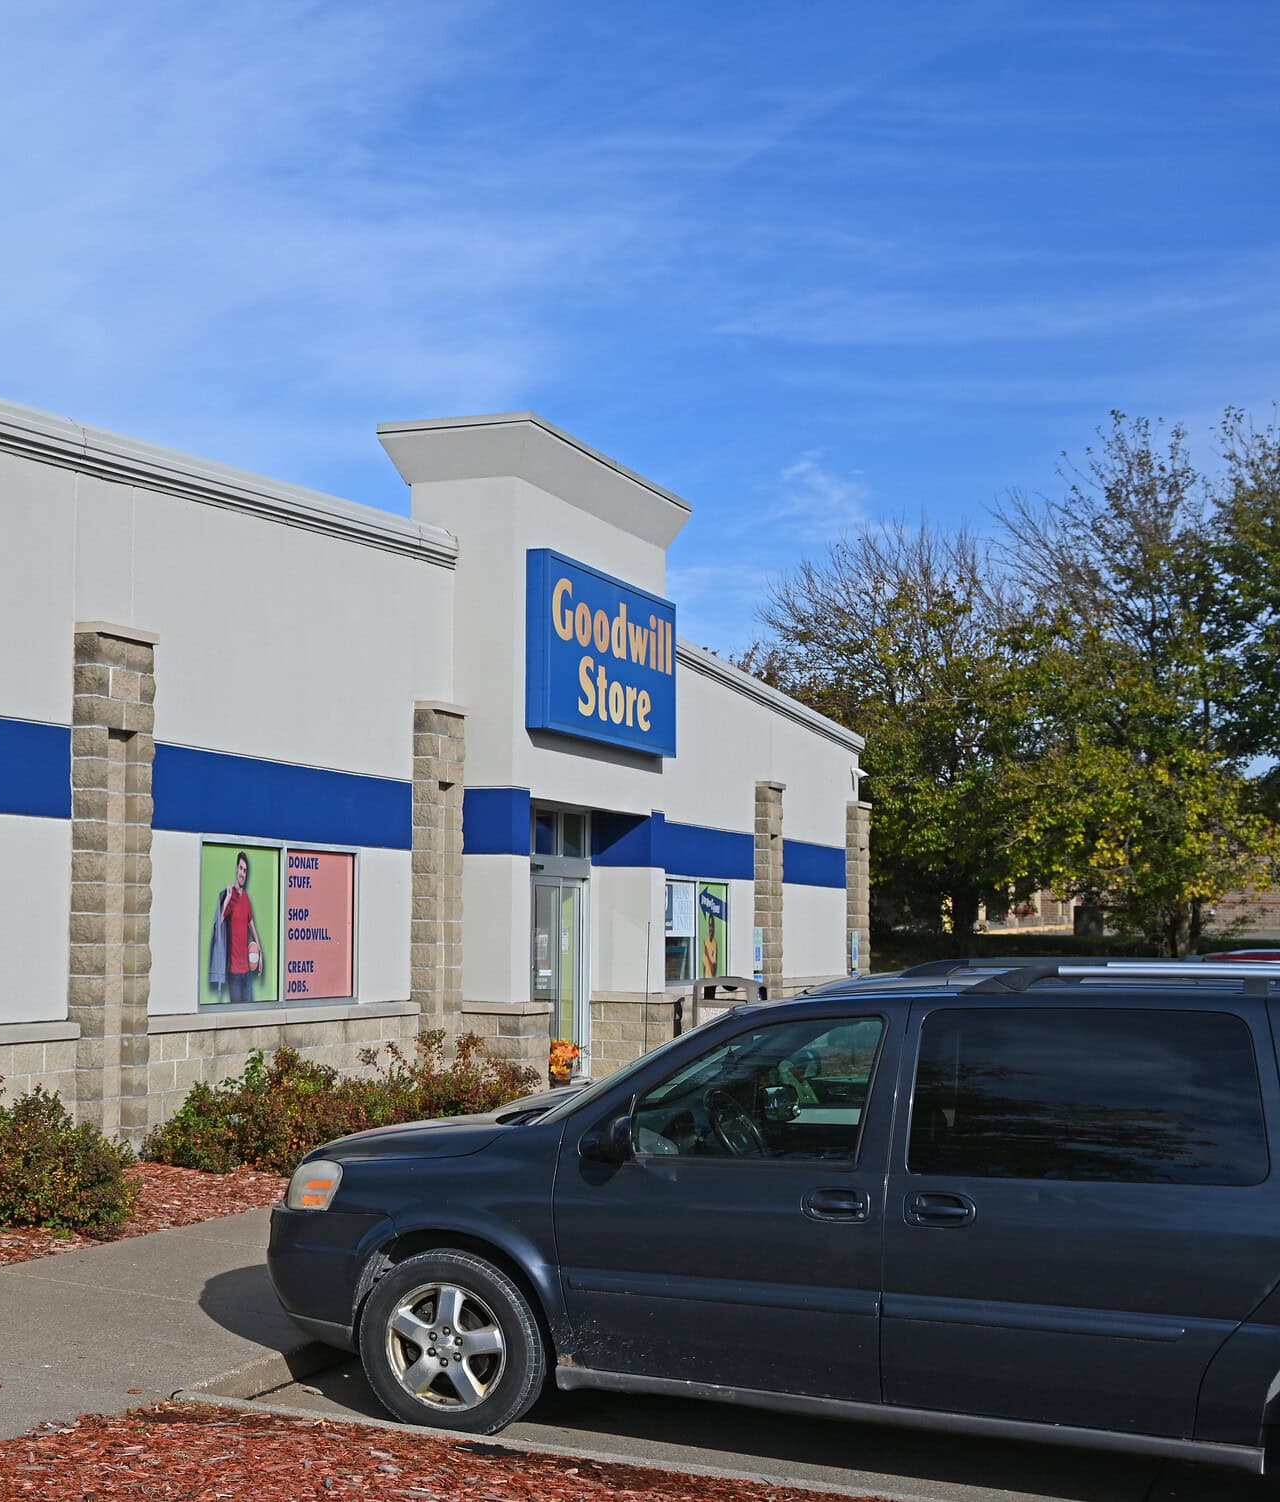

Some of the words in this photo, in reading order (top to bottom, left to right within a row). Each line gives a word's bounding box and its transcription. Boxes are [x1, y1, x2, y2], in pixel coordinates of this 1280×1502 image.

[552, 578, 672, 675] Goodwill
[578, 656, 651, 731] Store
[288, 856, 319, 870] DONATE
[288, 876, 312, 889] STUFF.
[288, 909, 309, 921] SHOP
[288, 928, 332, 941] GOODWILL.
[287, 961, 314, 974] CREATE
[287, 980, 309, 993] JOBS.
